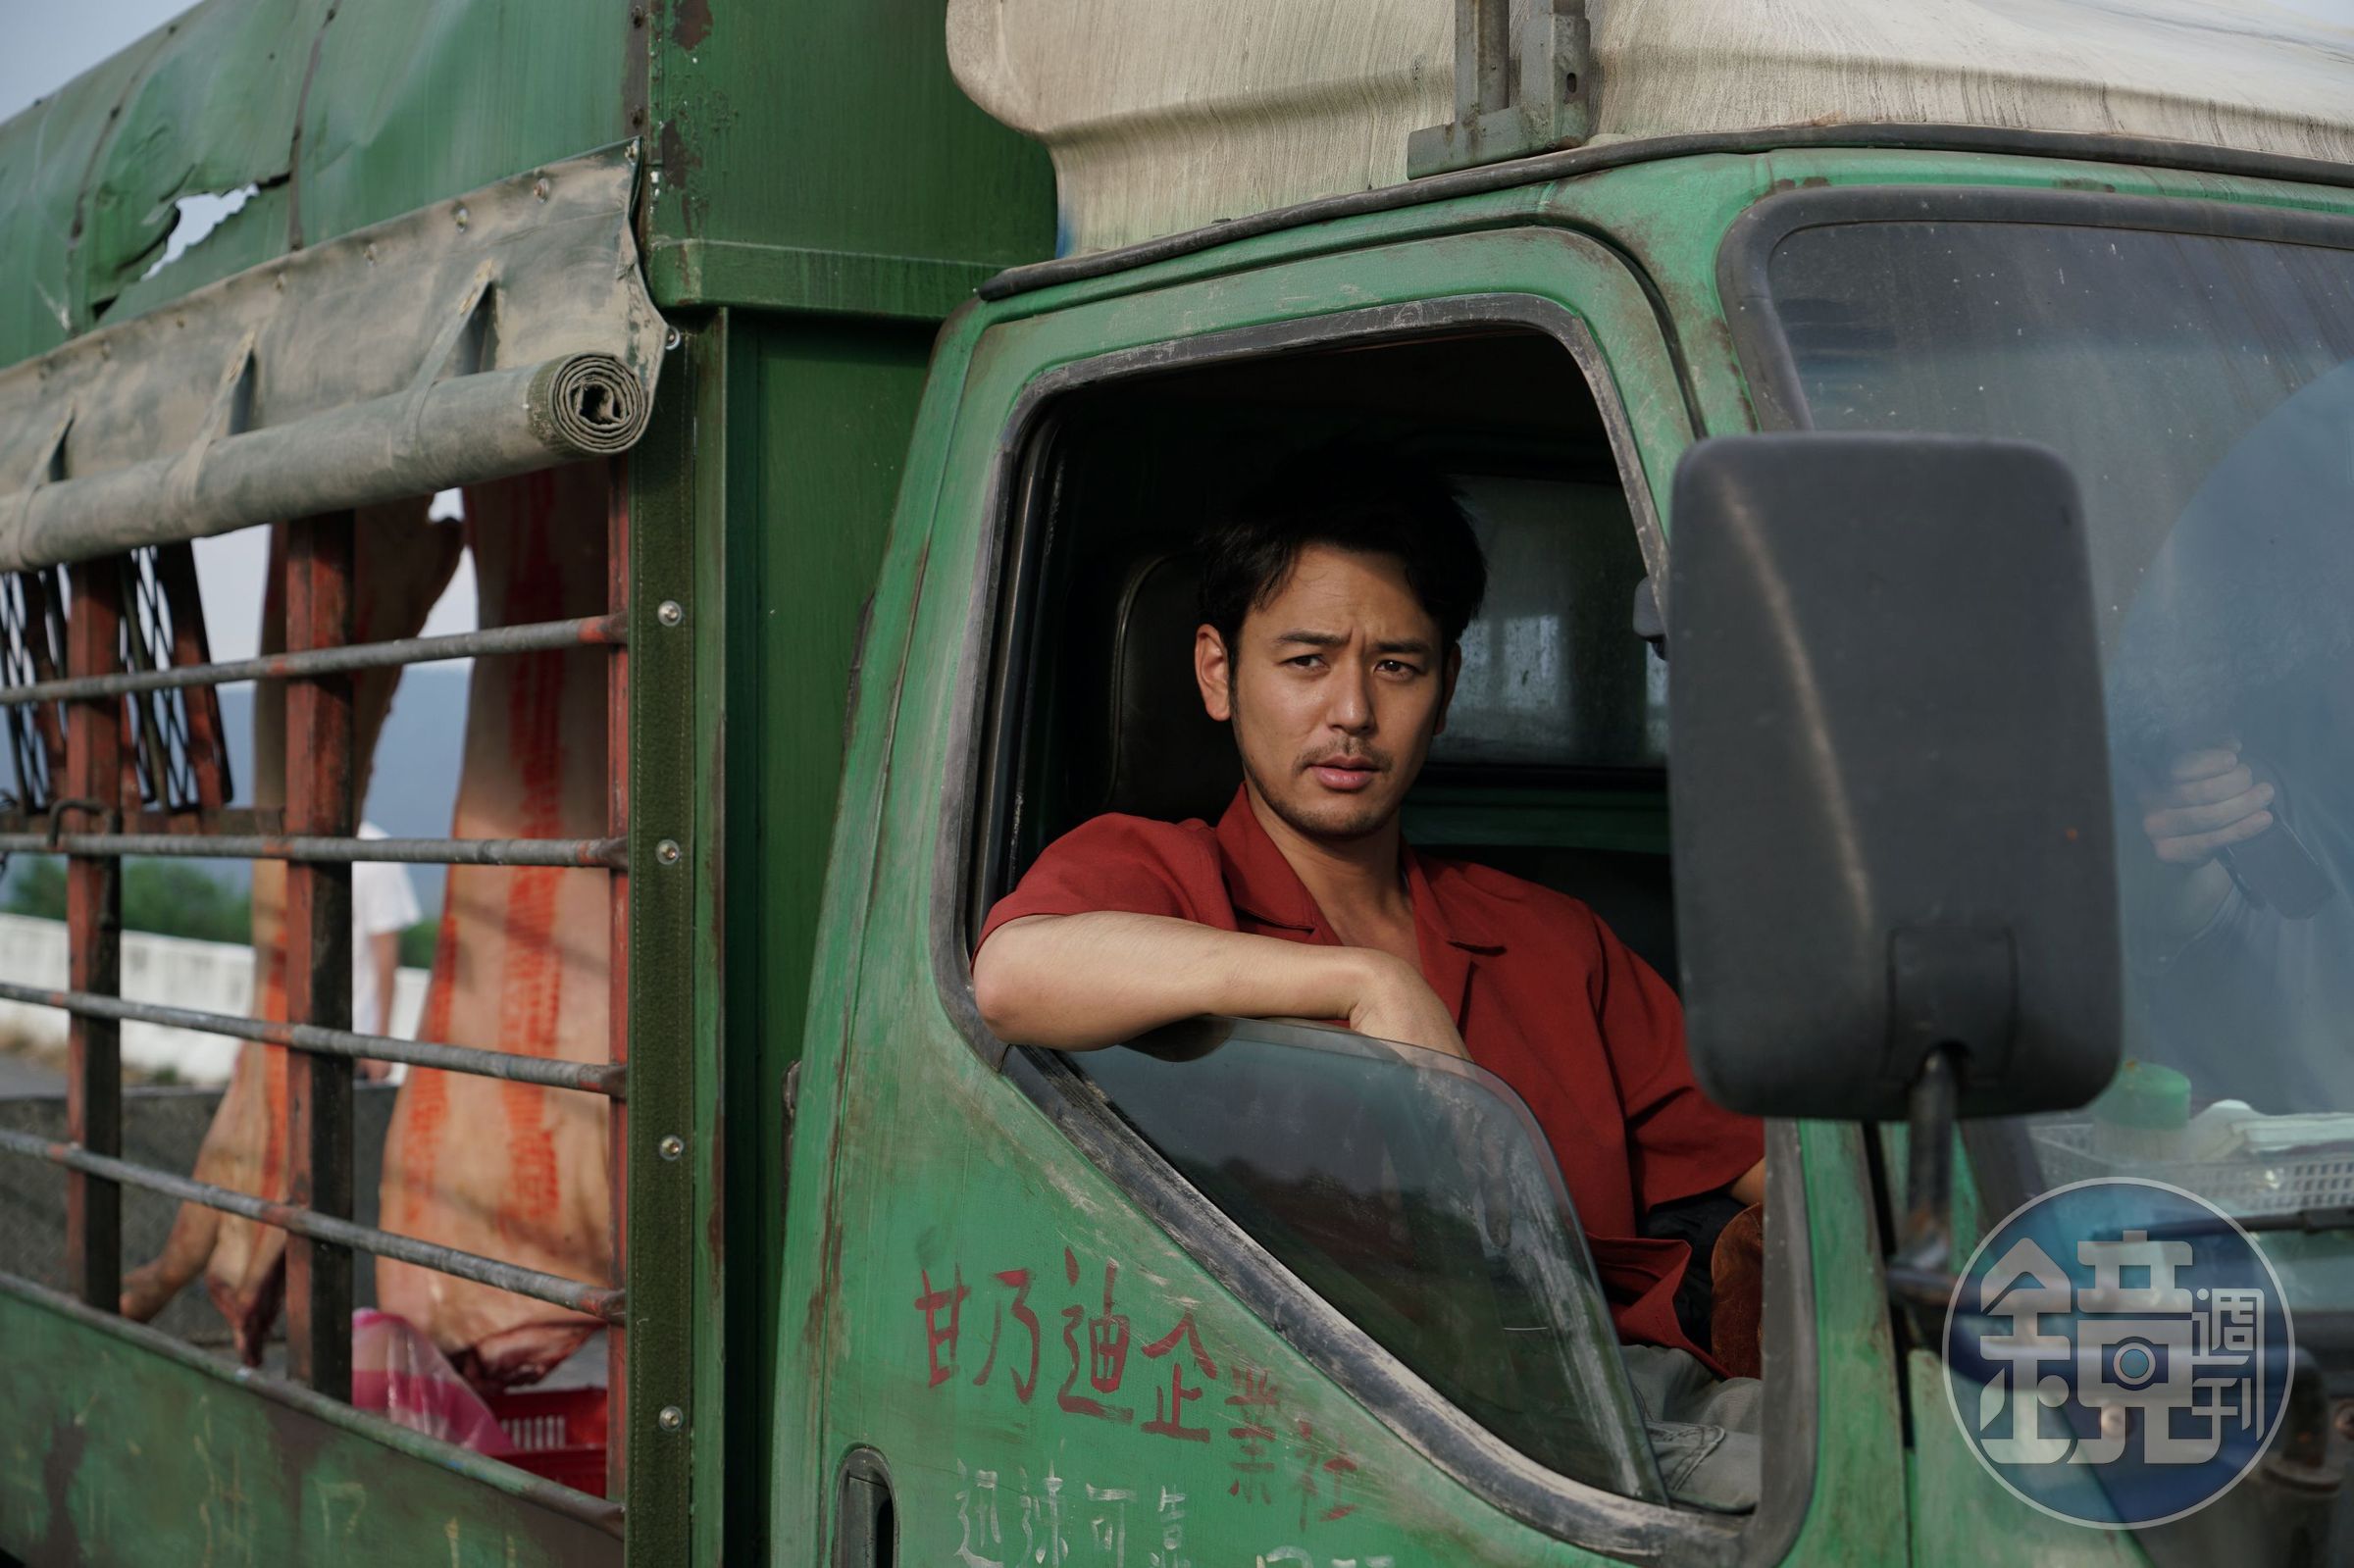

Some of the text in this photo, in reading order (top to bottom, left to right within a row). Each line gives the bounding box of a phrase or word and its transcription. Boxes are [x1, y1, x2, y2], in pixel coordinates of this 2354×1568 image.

[914, 1246, 1358, 1532] 甘乃迪企業社
